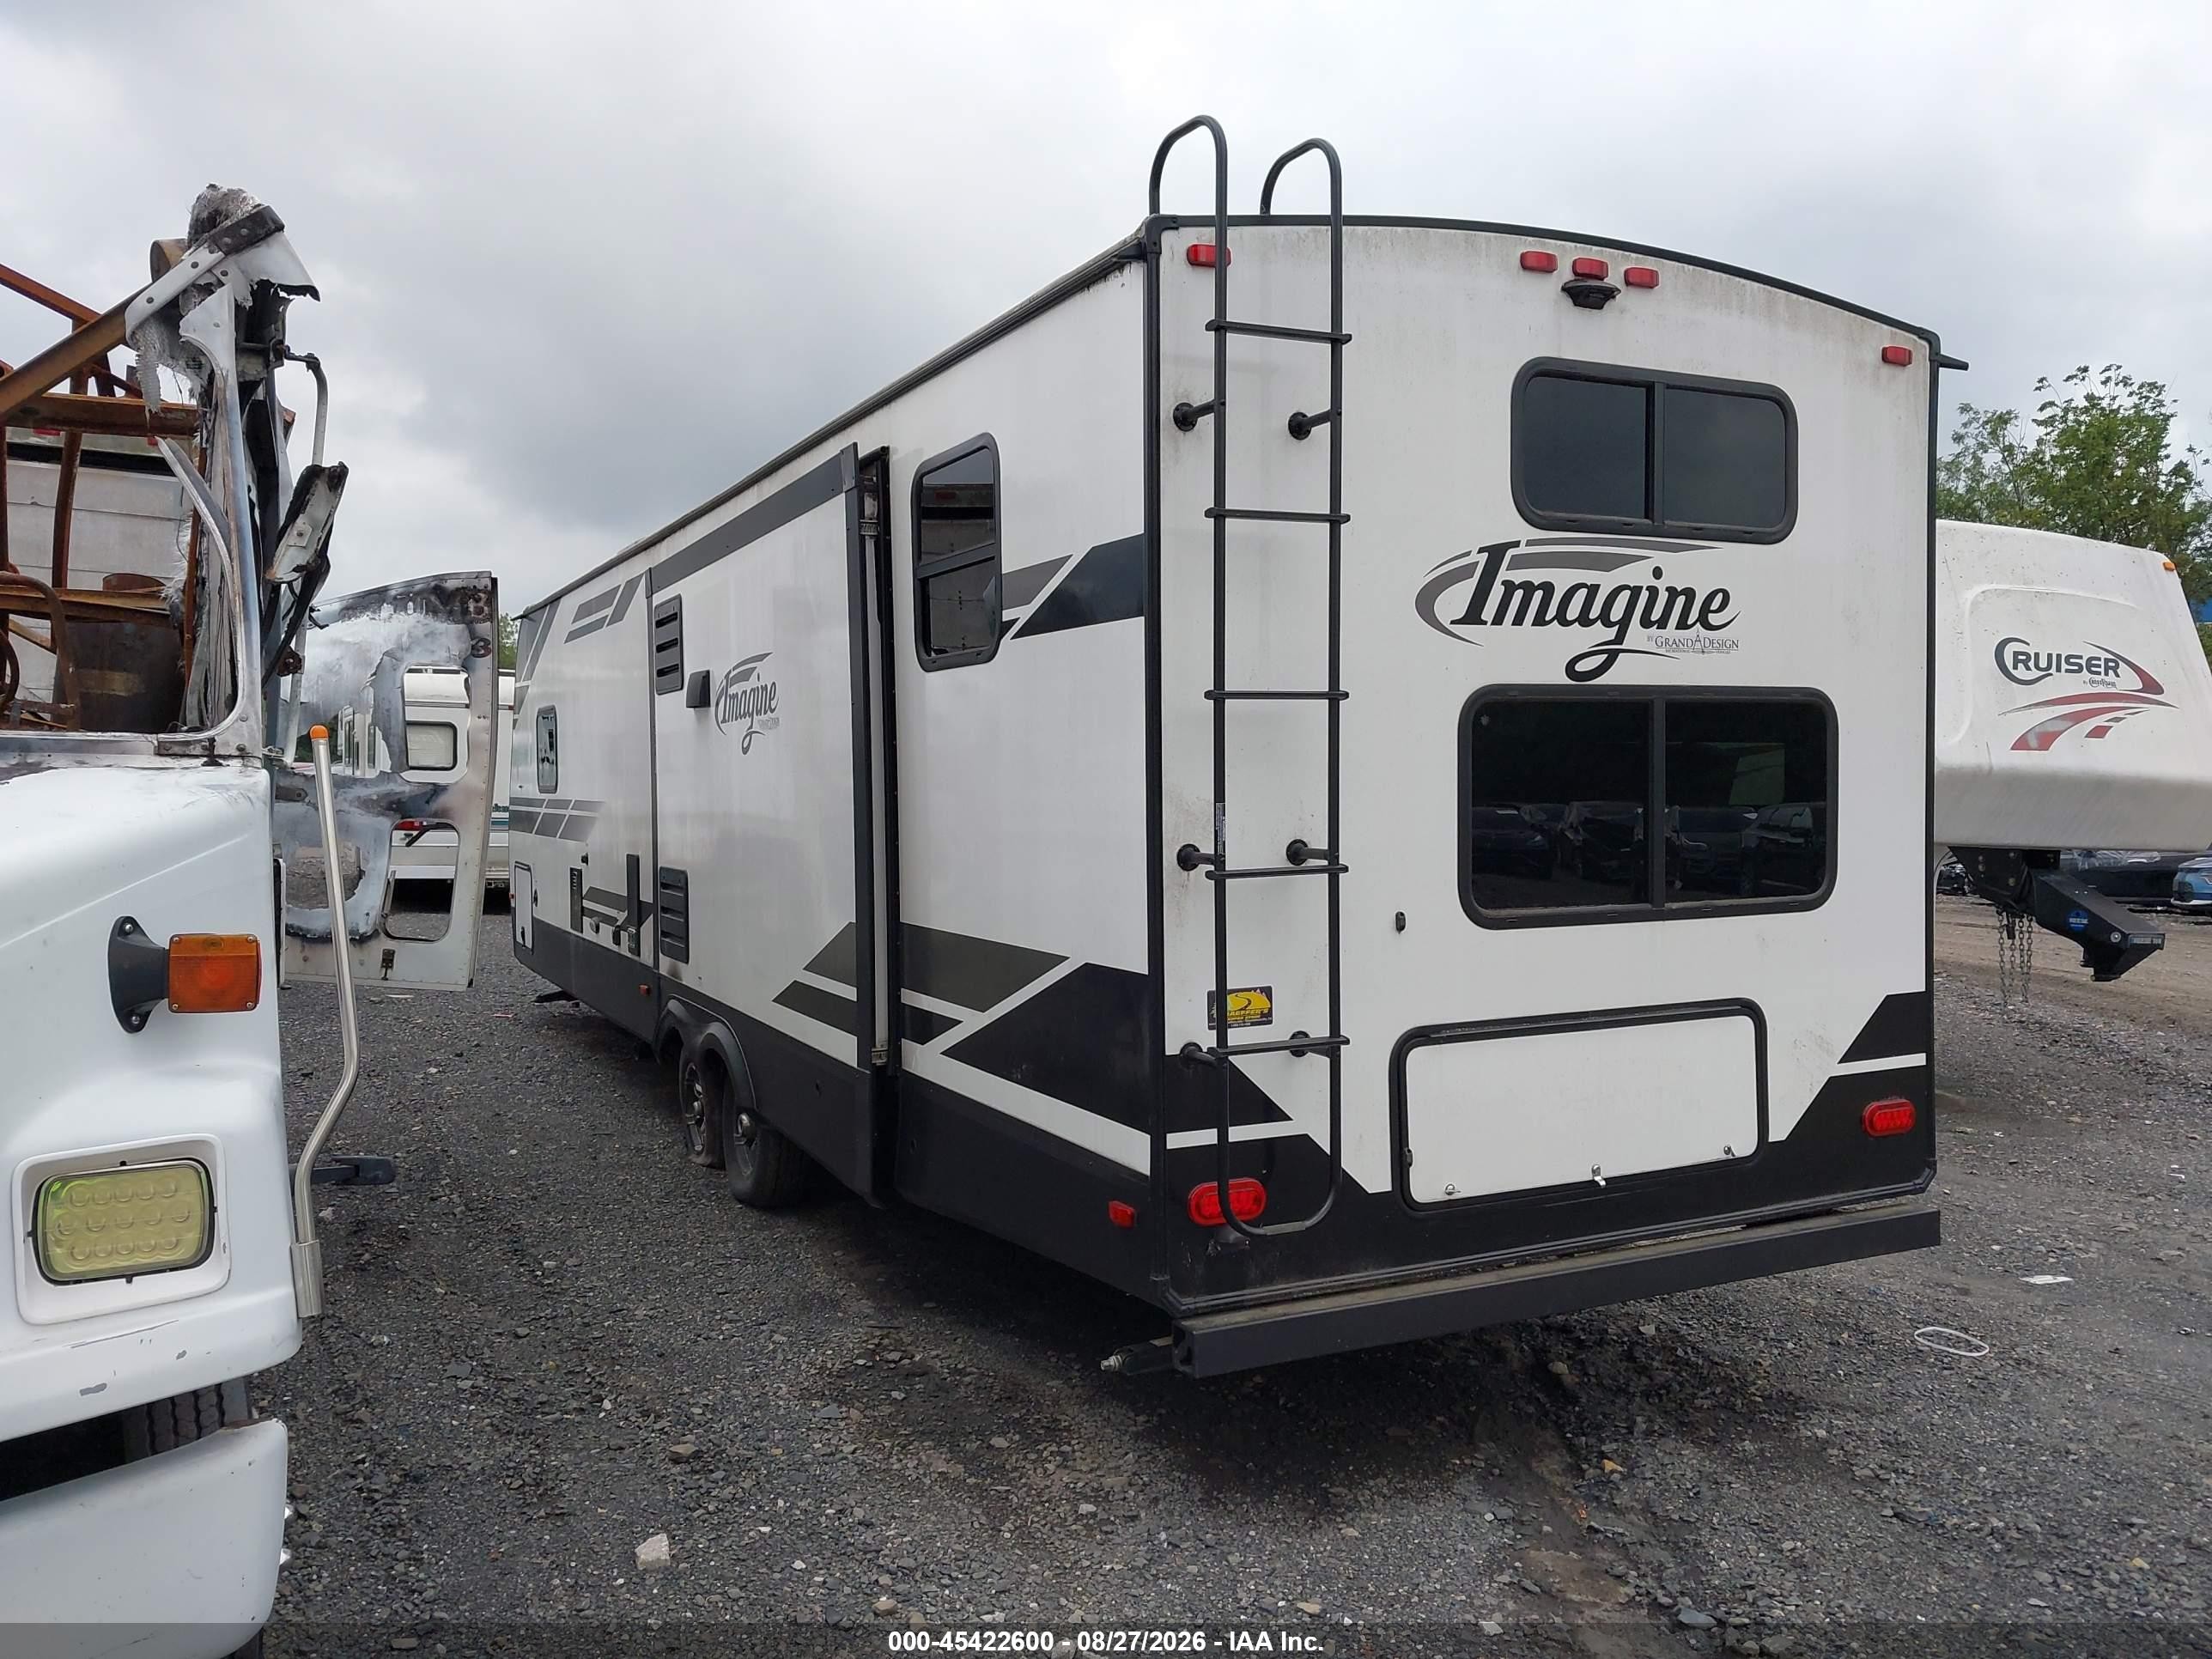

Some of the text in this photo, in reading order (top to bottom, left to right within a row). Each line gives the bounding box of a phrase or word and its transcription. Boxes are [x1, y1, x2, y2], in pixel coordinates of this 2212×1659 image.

[1450, 539, 1741, 683] Imagine
[1994, 637, 2121, 686] CRUISER
[720, 670, 780, 756] Imagine
